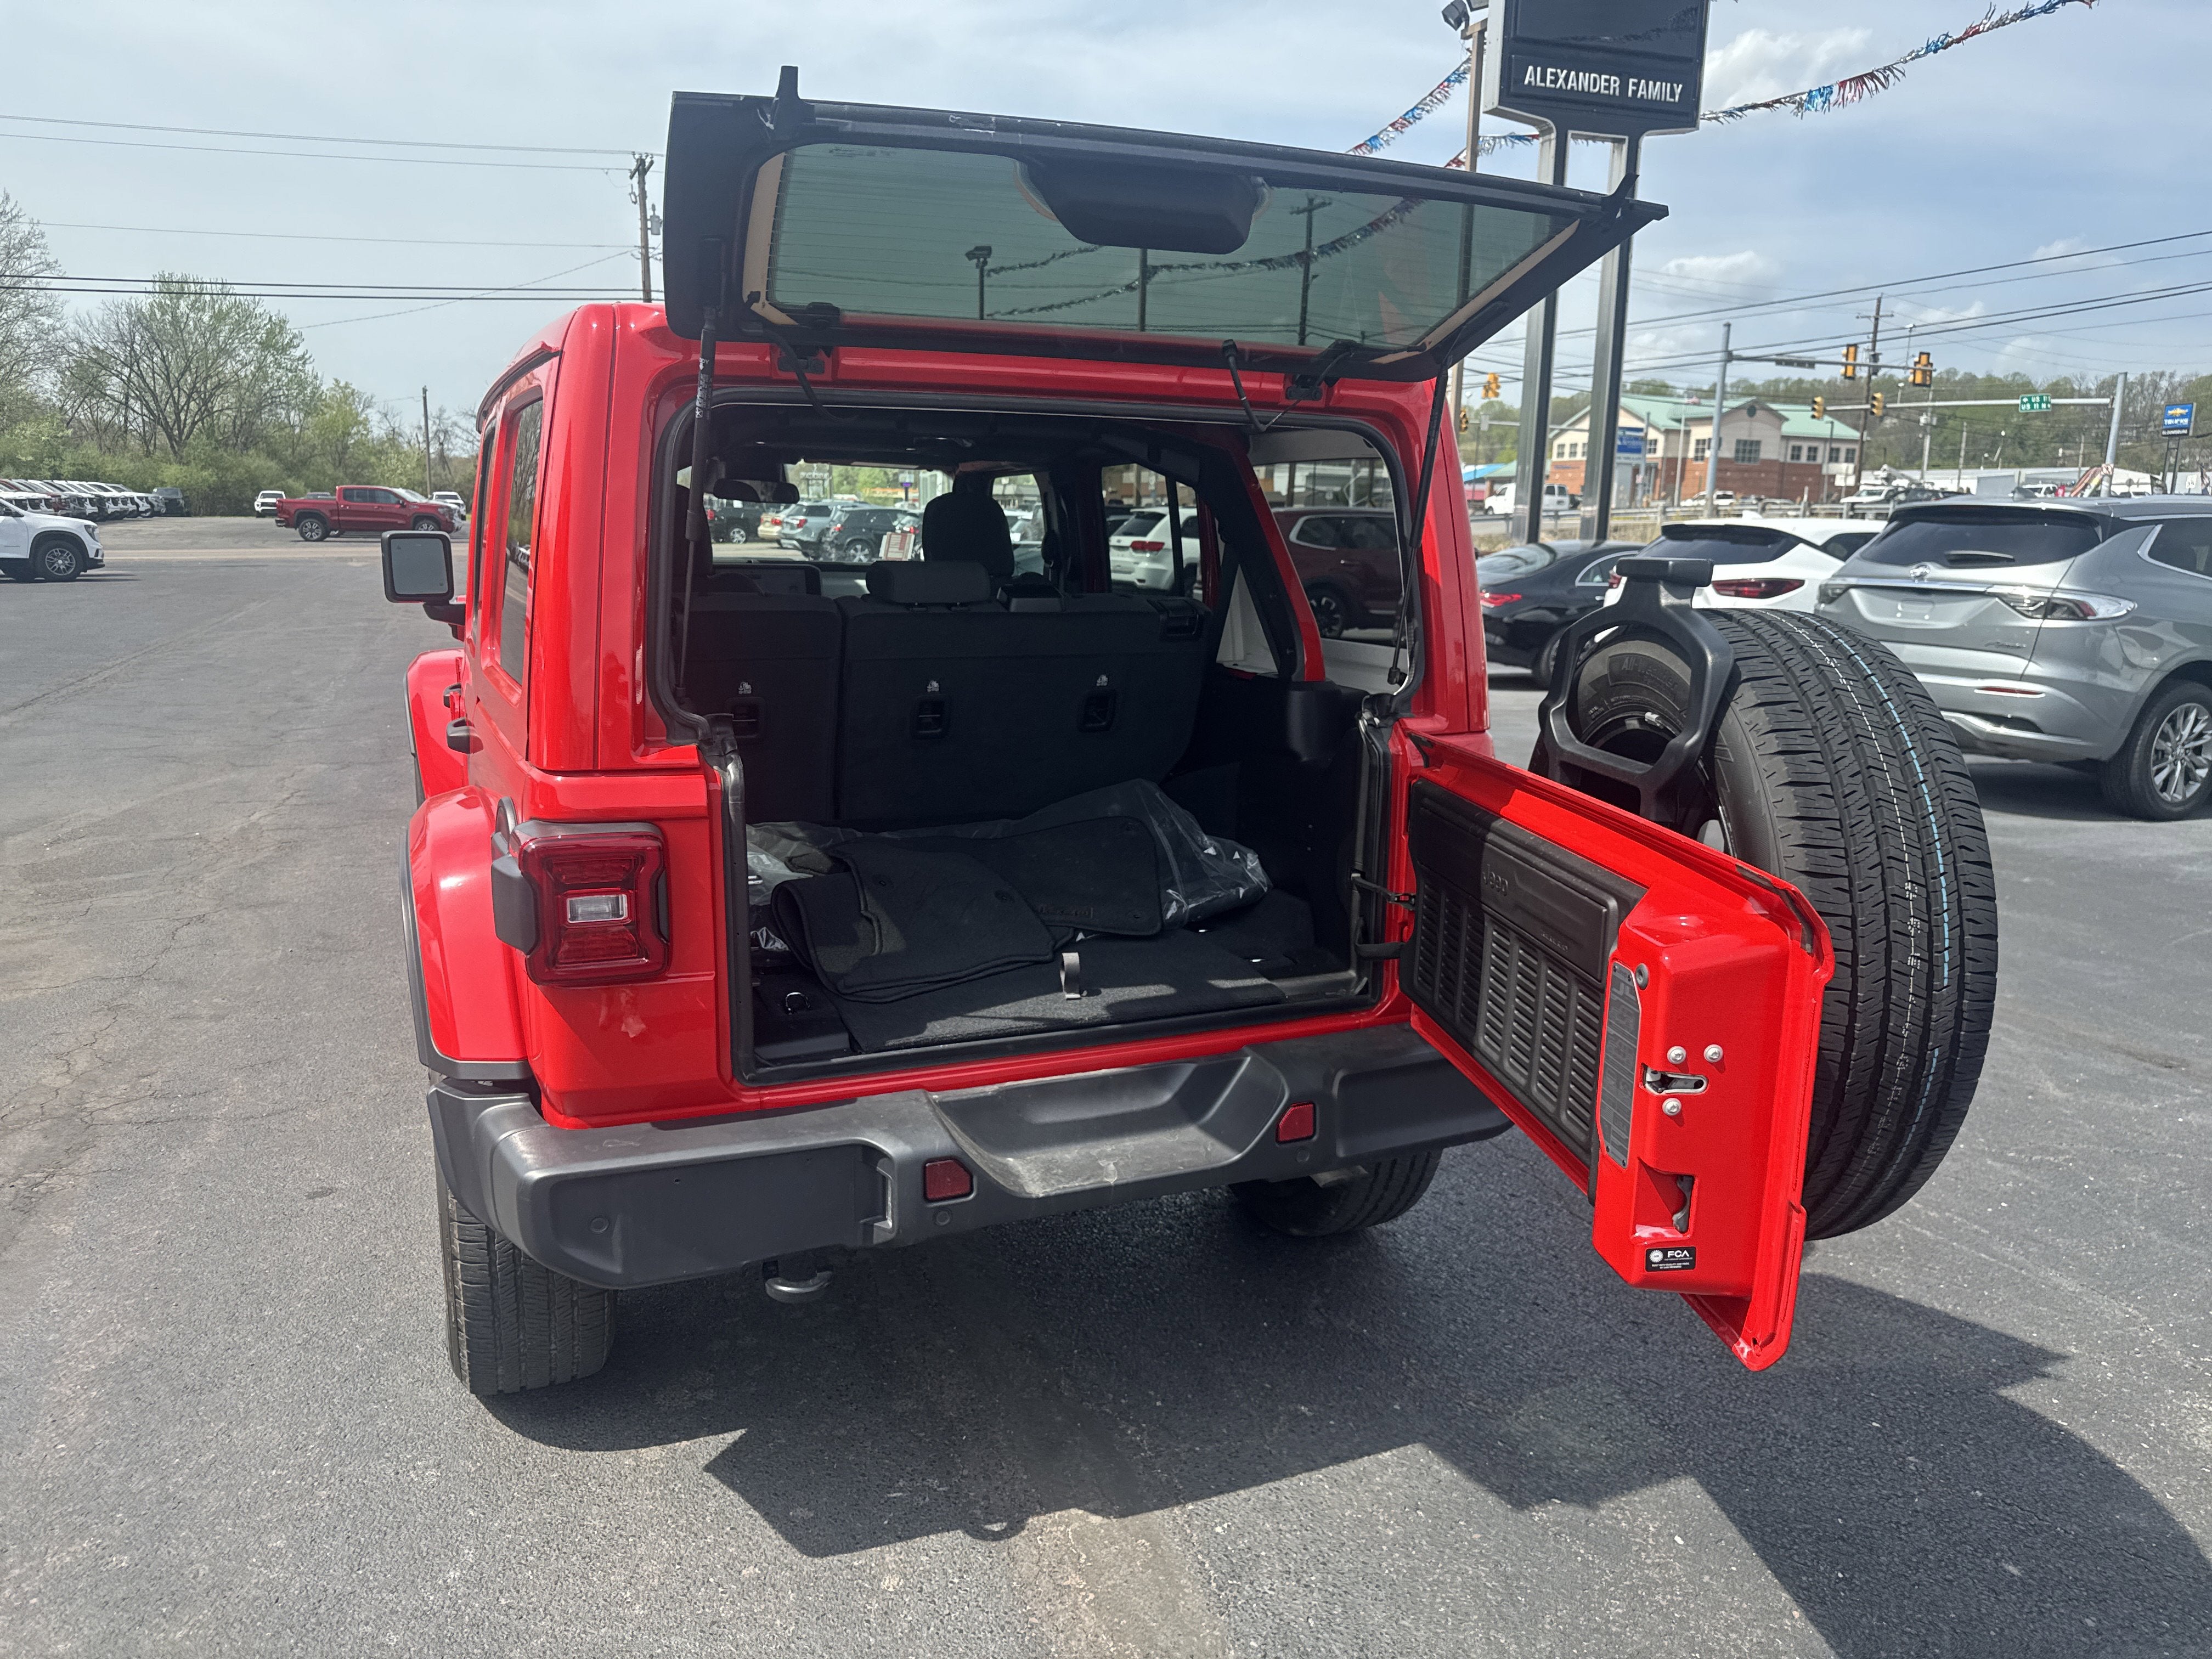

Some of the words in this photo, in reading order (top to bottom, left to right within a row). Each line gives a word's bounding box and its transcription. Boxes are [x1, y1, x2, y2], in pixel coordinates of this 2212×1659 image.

[1524, 65, 1620, 97] ALEXANDER
[1628, 78, 1683, 103] FAMILY
[1482, 864, 1509, 897] Jeep
[1667, 1250, 1690, 1258] FCA
